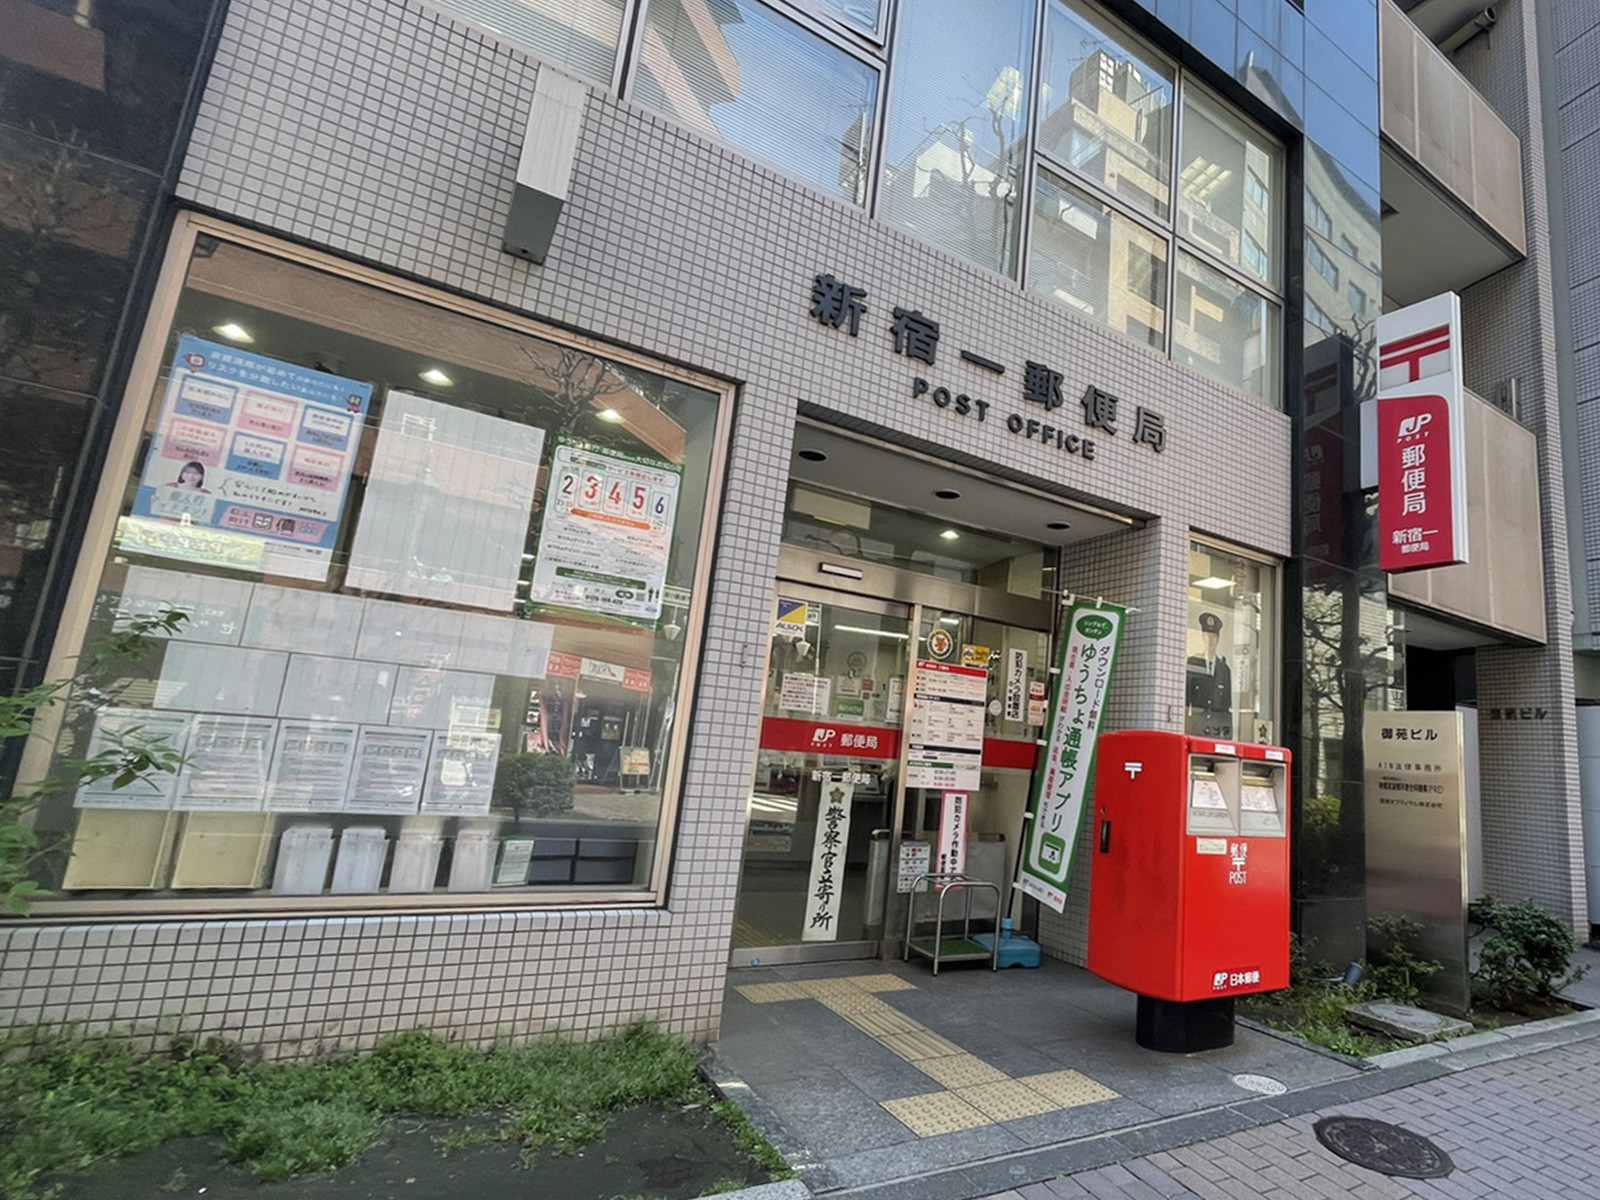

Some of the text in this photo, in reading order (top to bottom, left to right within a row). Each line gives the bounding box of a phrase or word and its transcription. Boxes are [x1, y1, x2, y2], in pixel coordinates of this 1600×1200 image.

[810, 274, 1167, 453] 新宿一郵便局
[912, 377, 1095, 460] POST OFFICE
[1396, 431, 1430, 444] POST
[1401, 443, 1426, 516] 郵便局
[562, 475, 664, 514] 2 3 4 5 6
[1392, 528, 1439, 545] 新宿一
[1401, 541, 1430, 554] 郵便局
[776, 622, 803, 633] ALSOK
[1087, 645, 1110, 731] ダウンロード無料
[840, 733, 878, 750] 郵便局
[1051, 643, 1097, 832] ゆうちょ通帳アプリ
[1381, 727, 1438, 741] 御苑ビル
[811, 770, 871, 785] 新宿一郵便局
[1230, 843, 1248, 858] 郵便
[810, 805, 847, 931] 警察官立寄り所
[1229, 871, 1248, 884] POST
[1230, 970, 1260, 986] 日本郵便
